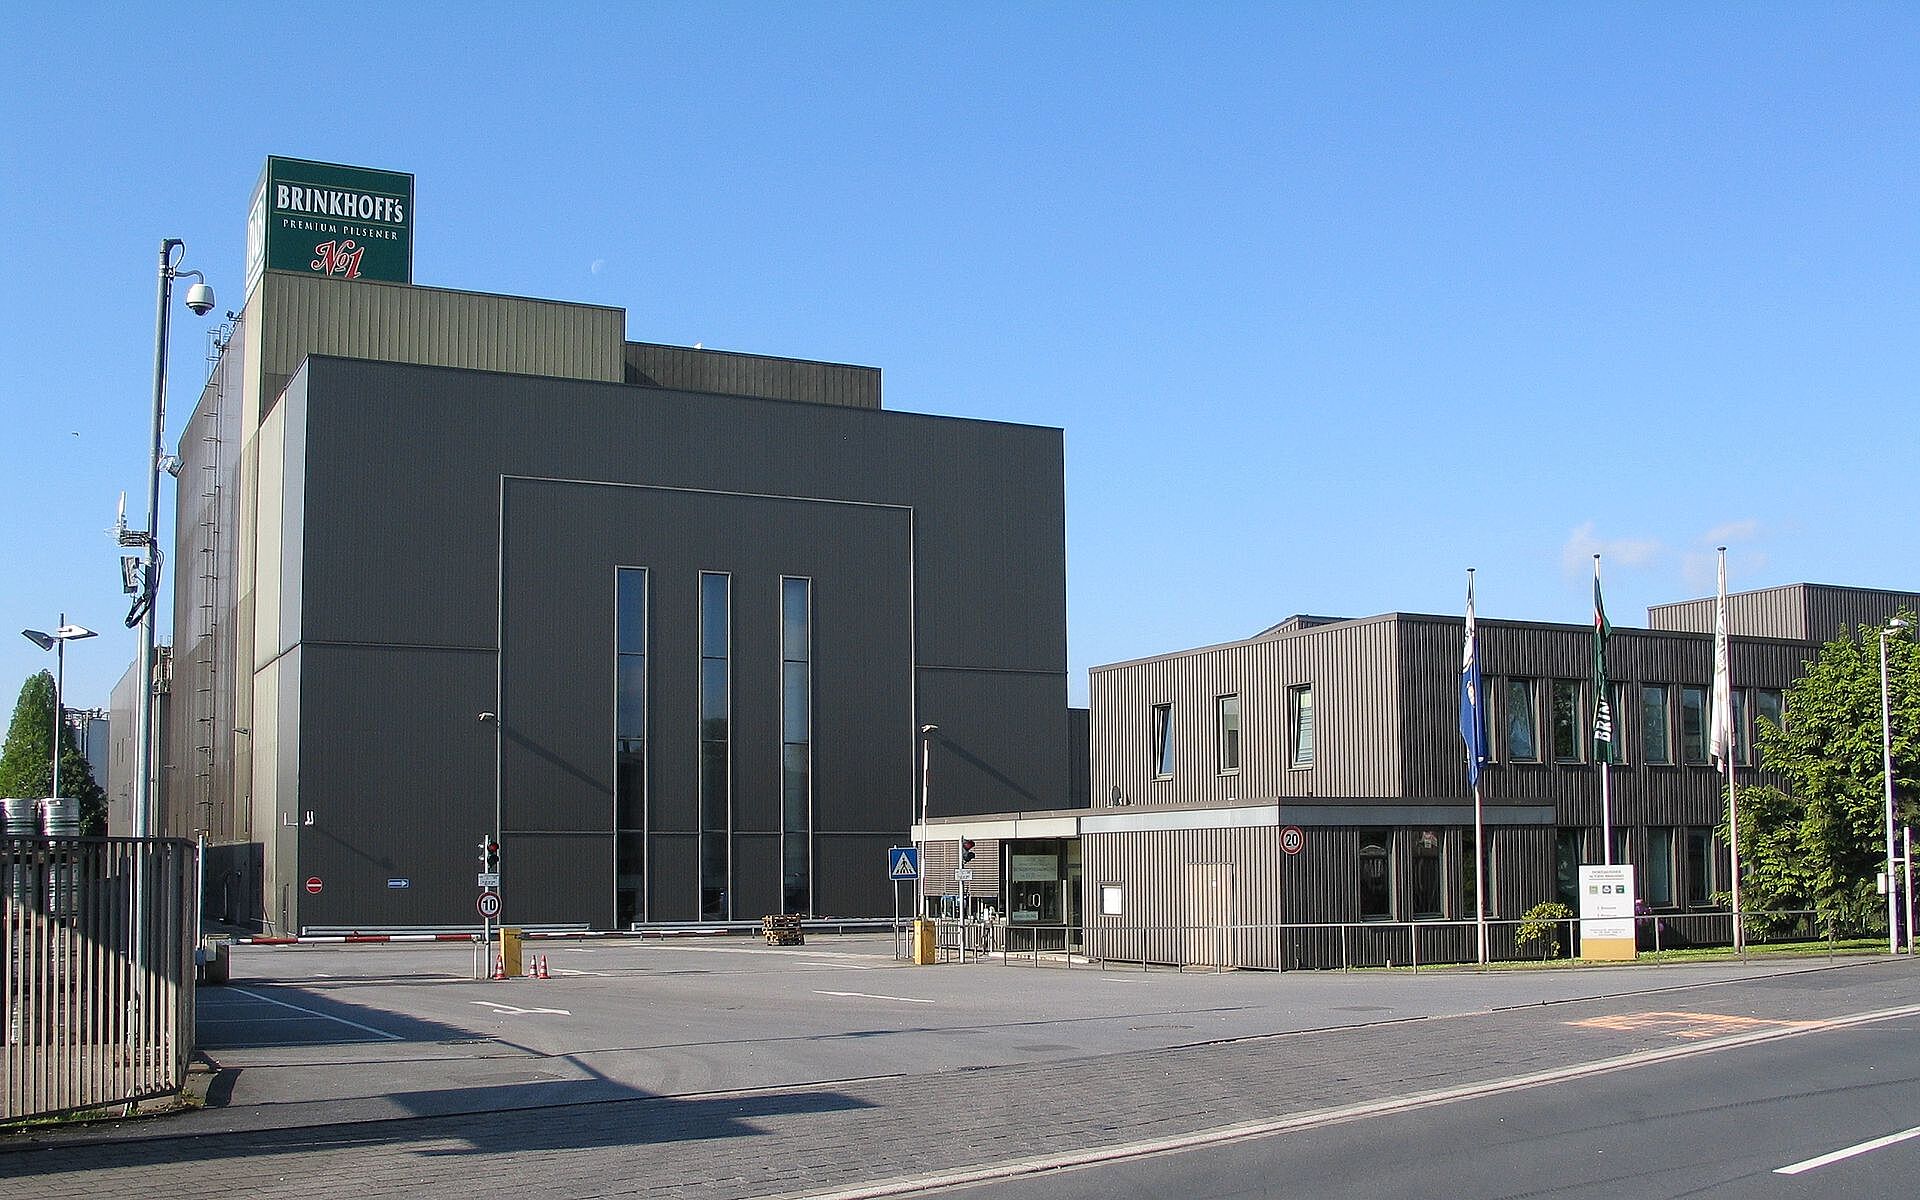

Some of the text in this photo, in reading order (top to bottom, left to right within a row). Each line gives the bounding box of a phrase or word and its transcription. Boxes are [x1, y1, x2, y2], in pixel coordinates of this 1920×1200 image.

[283, 218, 398, 241] PREMIUM PILSENER
[1285, 833, 1299, 847] 20
[482, 898, 497, 911] 10
